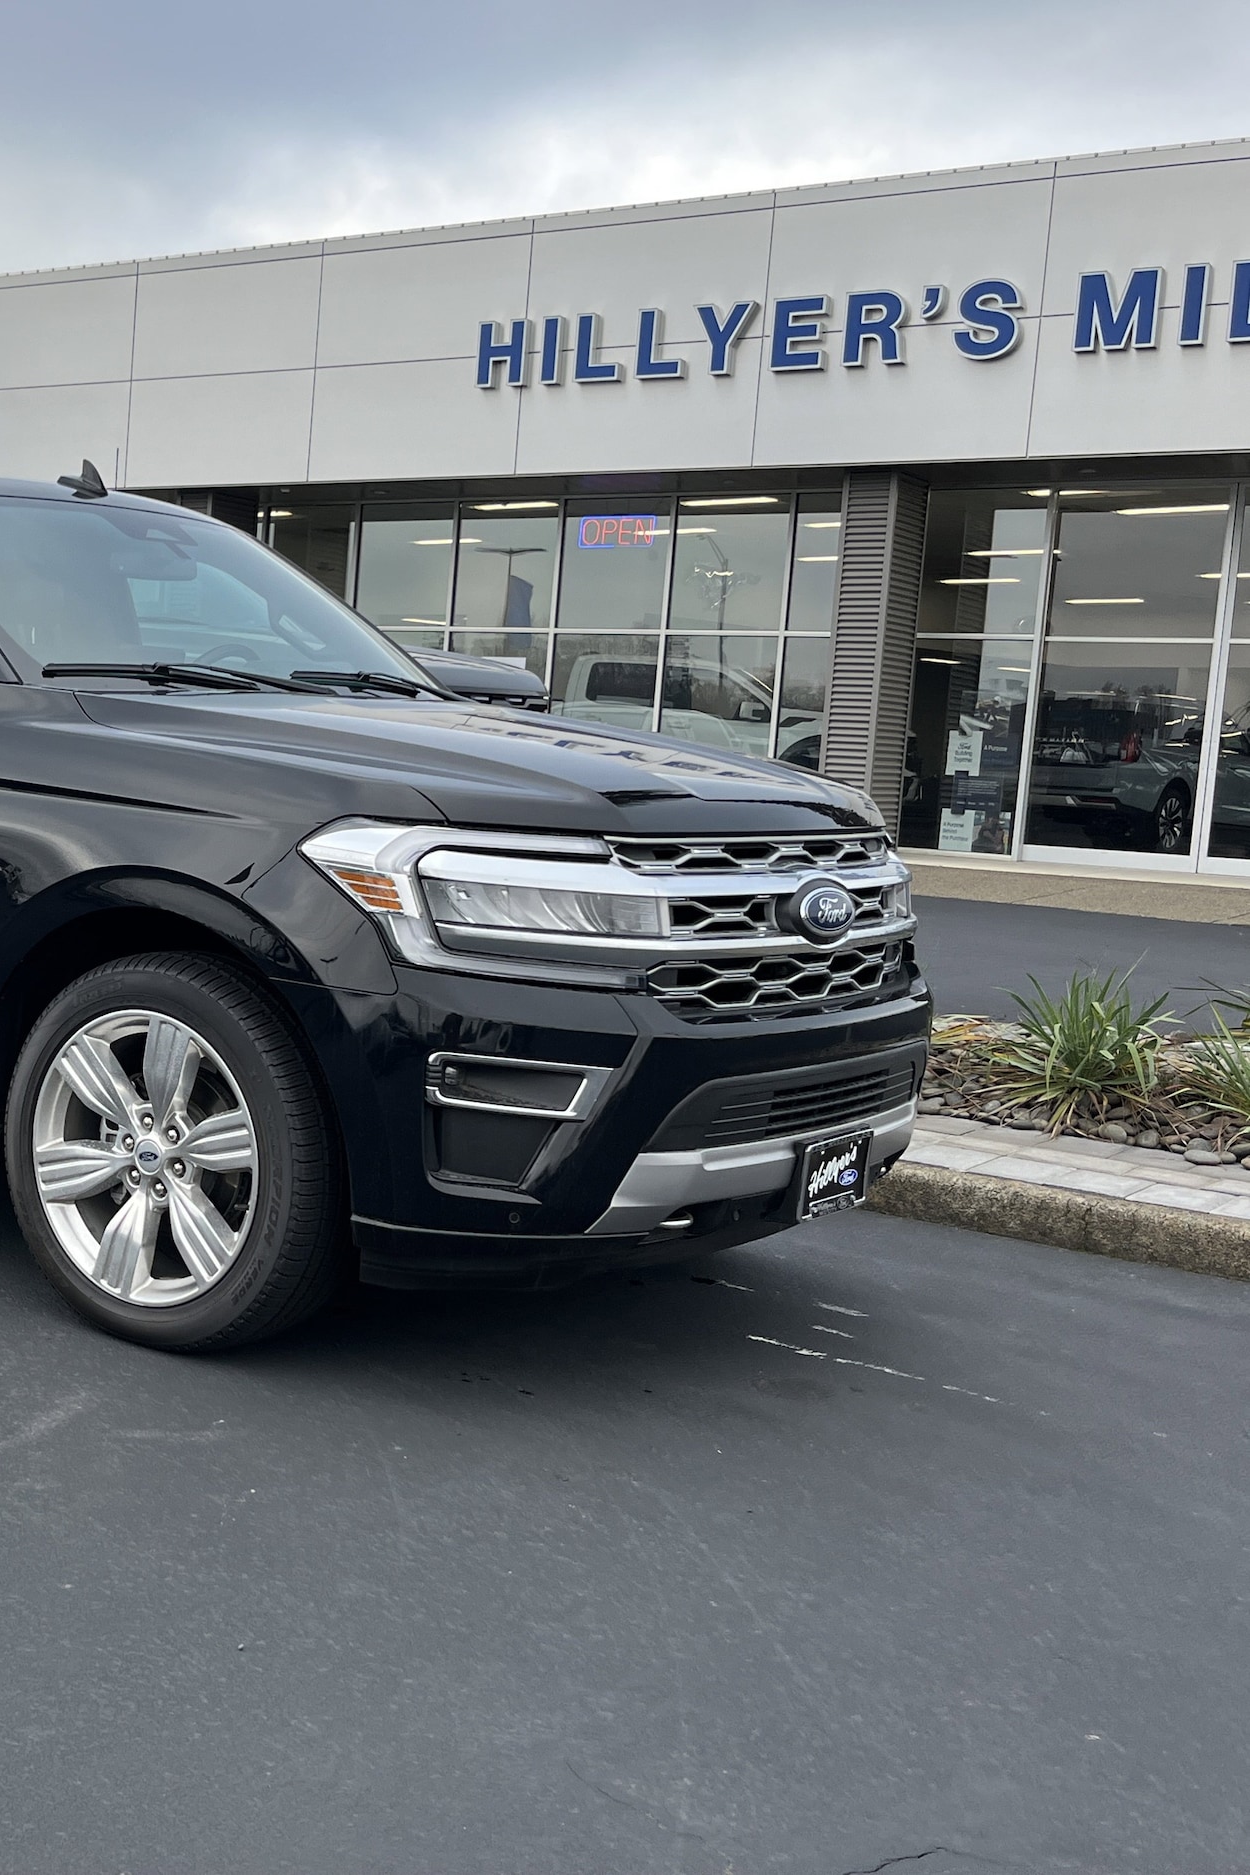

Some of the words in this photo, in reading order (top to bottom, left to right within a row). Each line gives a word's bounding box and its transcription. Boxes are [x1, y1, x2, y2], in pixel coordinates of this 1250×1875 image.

[475, 278, 1023, 389] HILLYER'S
[582, 519, 654, 545] OPEN
[817, 897, 847, 924] Ford
